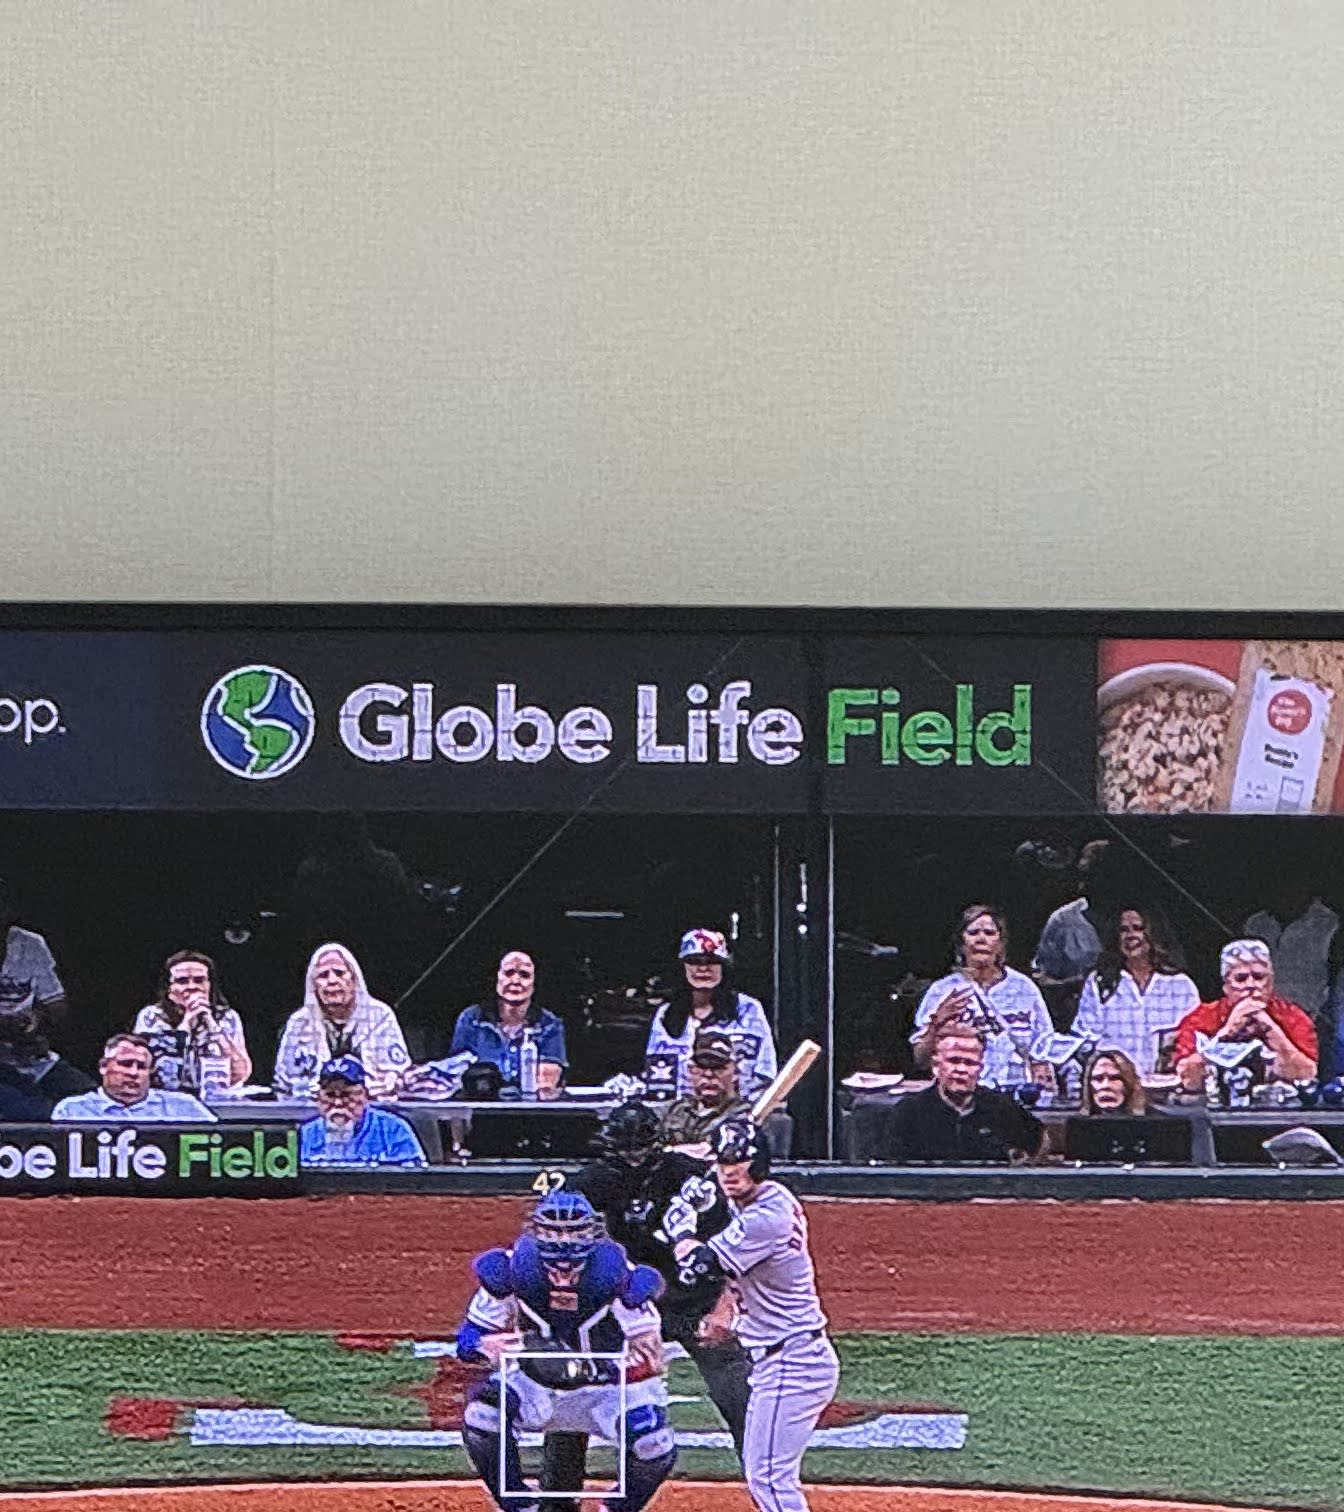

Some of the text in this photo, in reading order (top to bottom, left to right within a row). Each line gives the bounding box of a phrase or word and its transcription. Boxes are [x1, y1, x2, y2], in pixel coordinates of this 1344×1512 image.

[339, 680, 1033, 766] Globe Life Field
[68, 1129, 167, 1180] Life
[178, 1130, 299, 1180] Field
